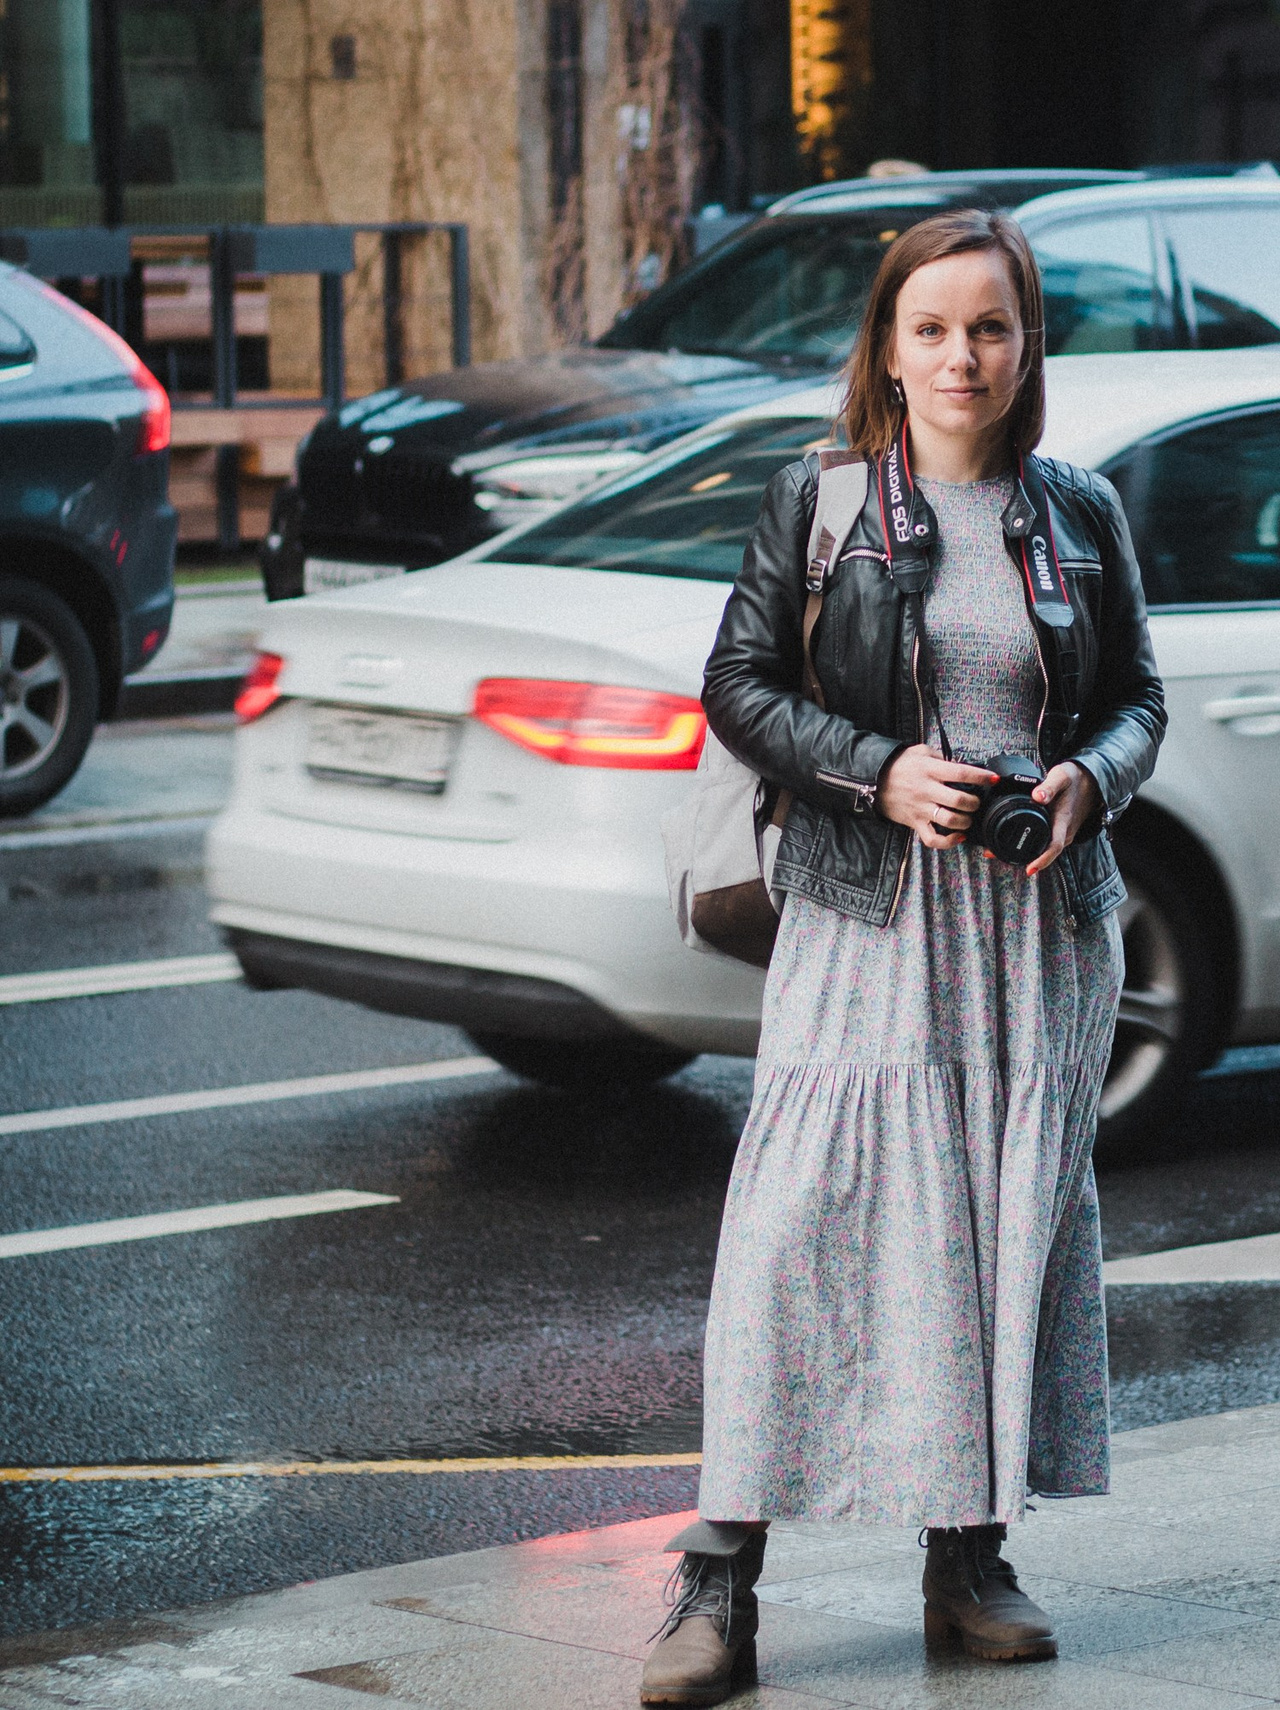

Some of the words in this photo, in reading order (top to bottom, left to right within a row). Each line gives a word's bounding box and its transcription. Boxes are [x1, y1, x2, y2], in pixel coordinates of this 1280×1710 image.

[888, 442, 902, 504] DIGITAL
[892, 506, 910, 542] EOS
[1032, 535, 1054, 591] Canon
[1014, 774, 1037, 783] Canon
[1016, 827, 1031, 850] Canon
